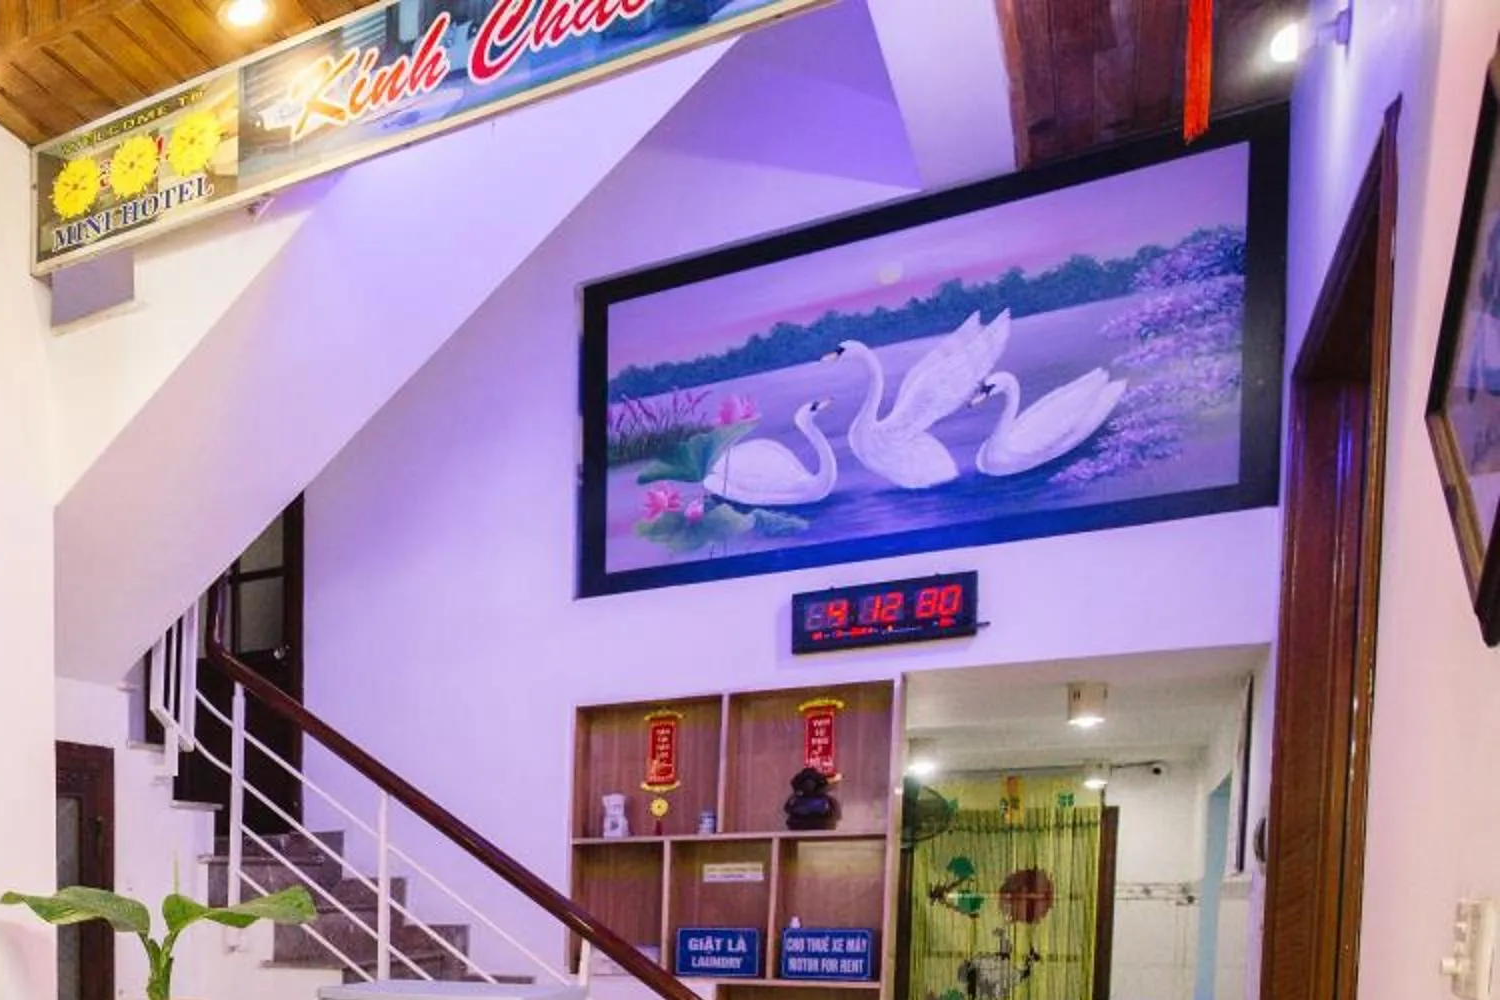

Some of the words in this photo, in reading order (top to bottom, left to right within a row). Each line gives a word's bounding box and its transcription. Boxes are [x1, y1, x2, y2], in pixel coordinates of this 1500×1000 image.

[289, 11, 450, 144] Kính
[52, 211, 112, 252] MINI
[122, 175, 215, 226] HOTEL
[691, 955, 743, 969] LAUNDRY
[788, 957, 819, 972] MOTOR
[821, 958, 839, 973] FOR
[839, 958, 864, 974] RENT
